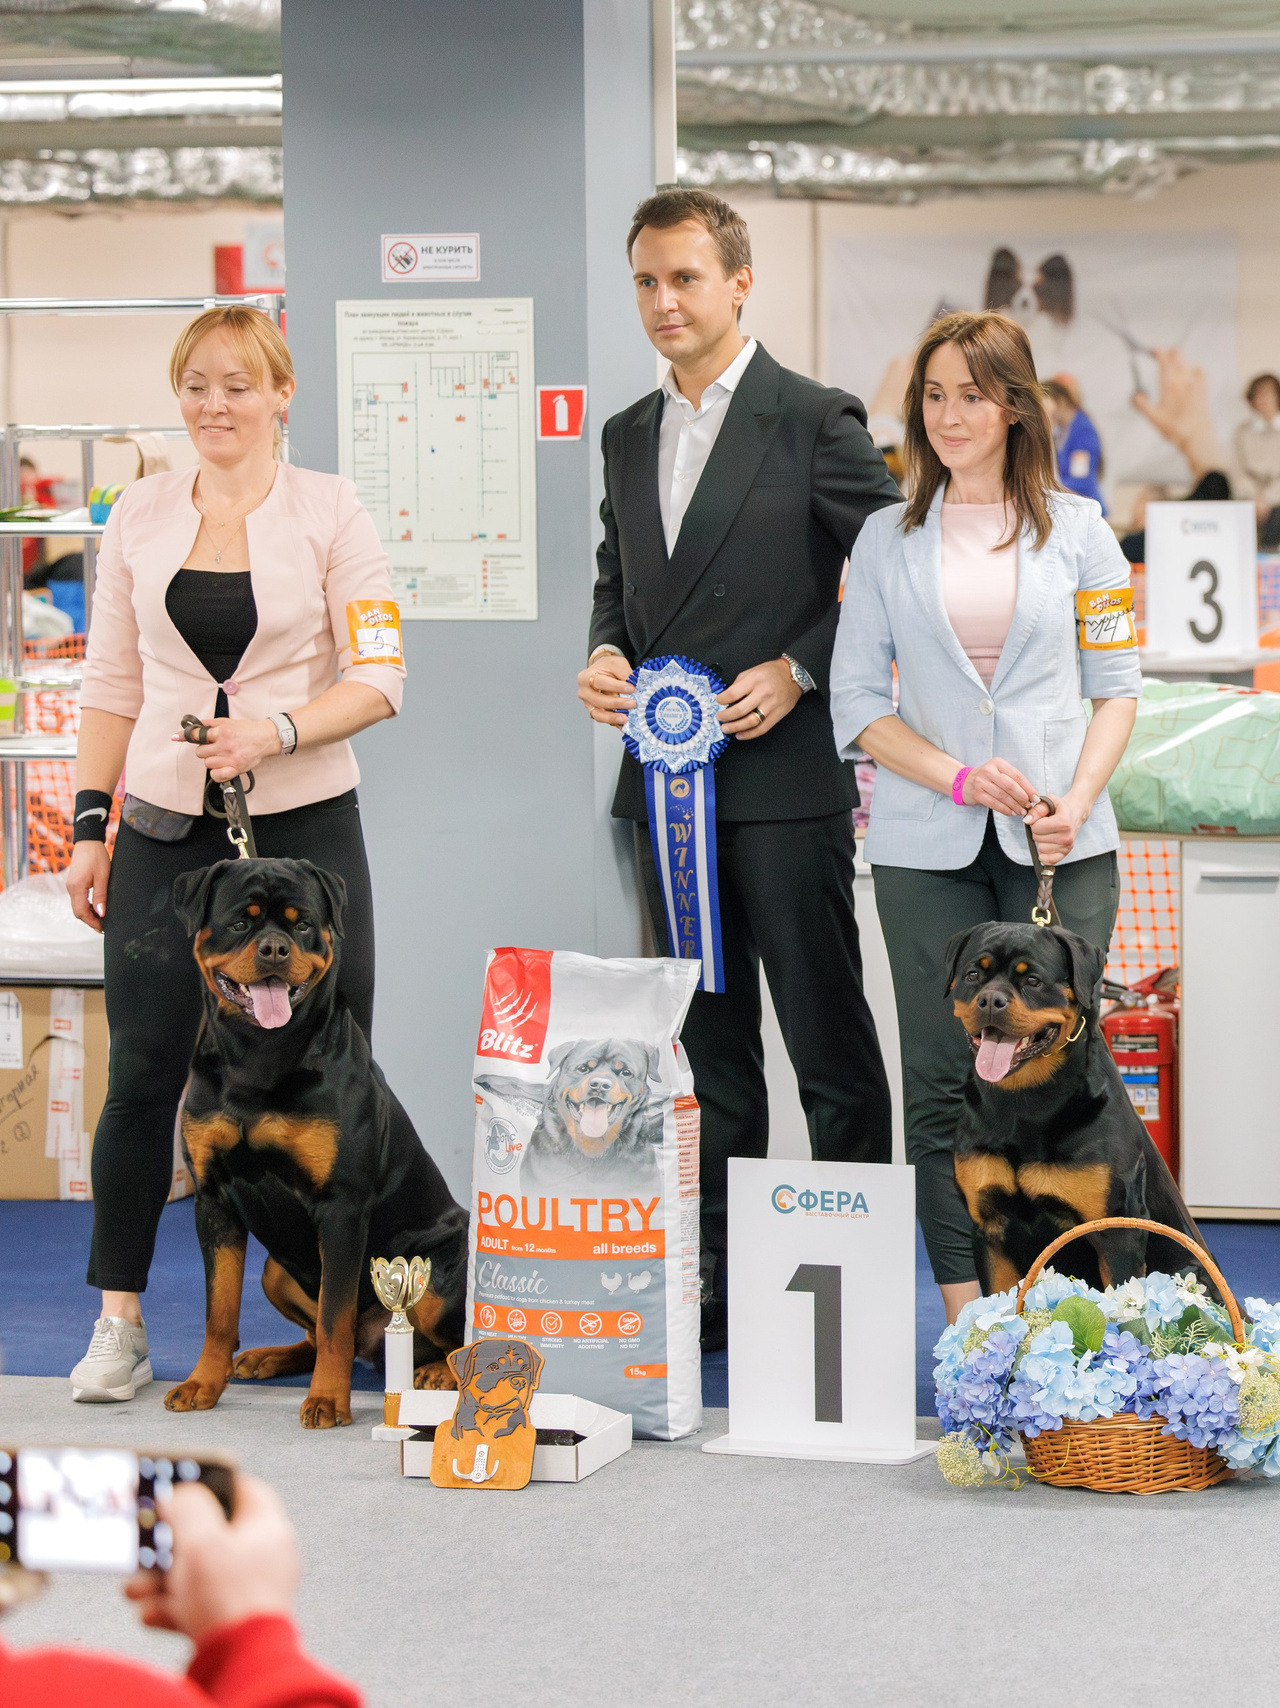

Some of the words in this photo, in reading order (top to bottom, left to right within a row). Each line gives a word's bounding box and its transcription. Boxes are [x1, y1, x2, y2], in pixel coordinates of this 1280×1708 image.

[421, 246, 434, 254] НЕ
[436, 245, 473, 254] КУРИТЬ
[1089, 593, 1111, 609] BAN
[1188, 560, 1223, 643] 3
[373, 628, 387, 650] 5
[669, 822, 697, 958] WINNER
[480, 1028, 535, 1059] Blitz
[505, 1141, 523, 1154] Live
[478, 1190, 662, 1232] POULTRY
[771, 1183, 869, 1215] СФЕРА
[480, 1235, 509, 1250] ADULT
[511, 1244, 524, 1252] from
[524, 1243, 535, 1253] 12
[535, 1246, 557, 1254] months
[592, 1243, 609, 1255] all
[611, 1242, 657, 1255] breeds
[478, 1260, 549, 1295] Classic
[516, 1296, 528, 1304] dogs
[784, 1263, 843, 1423] 1
